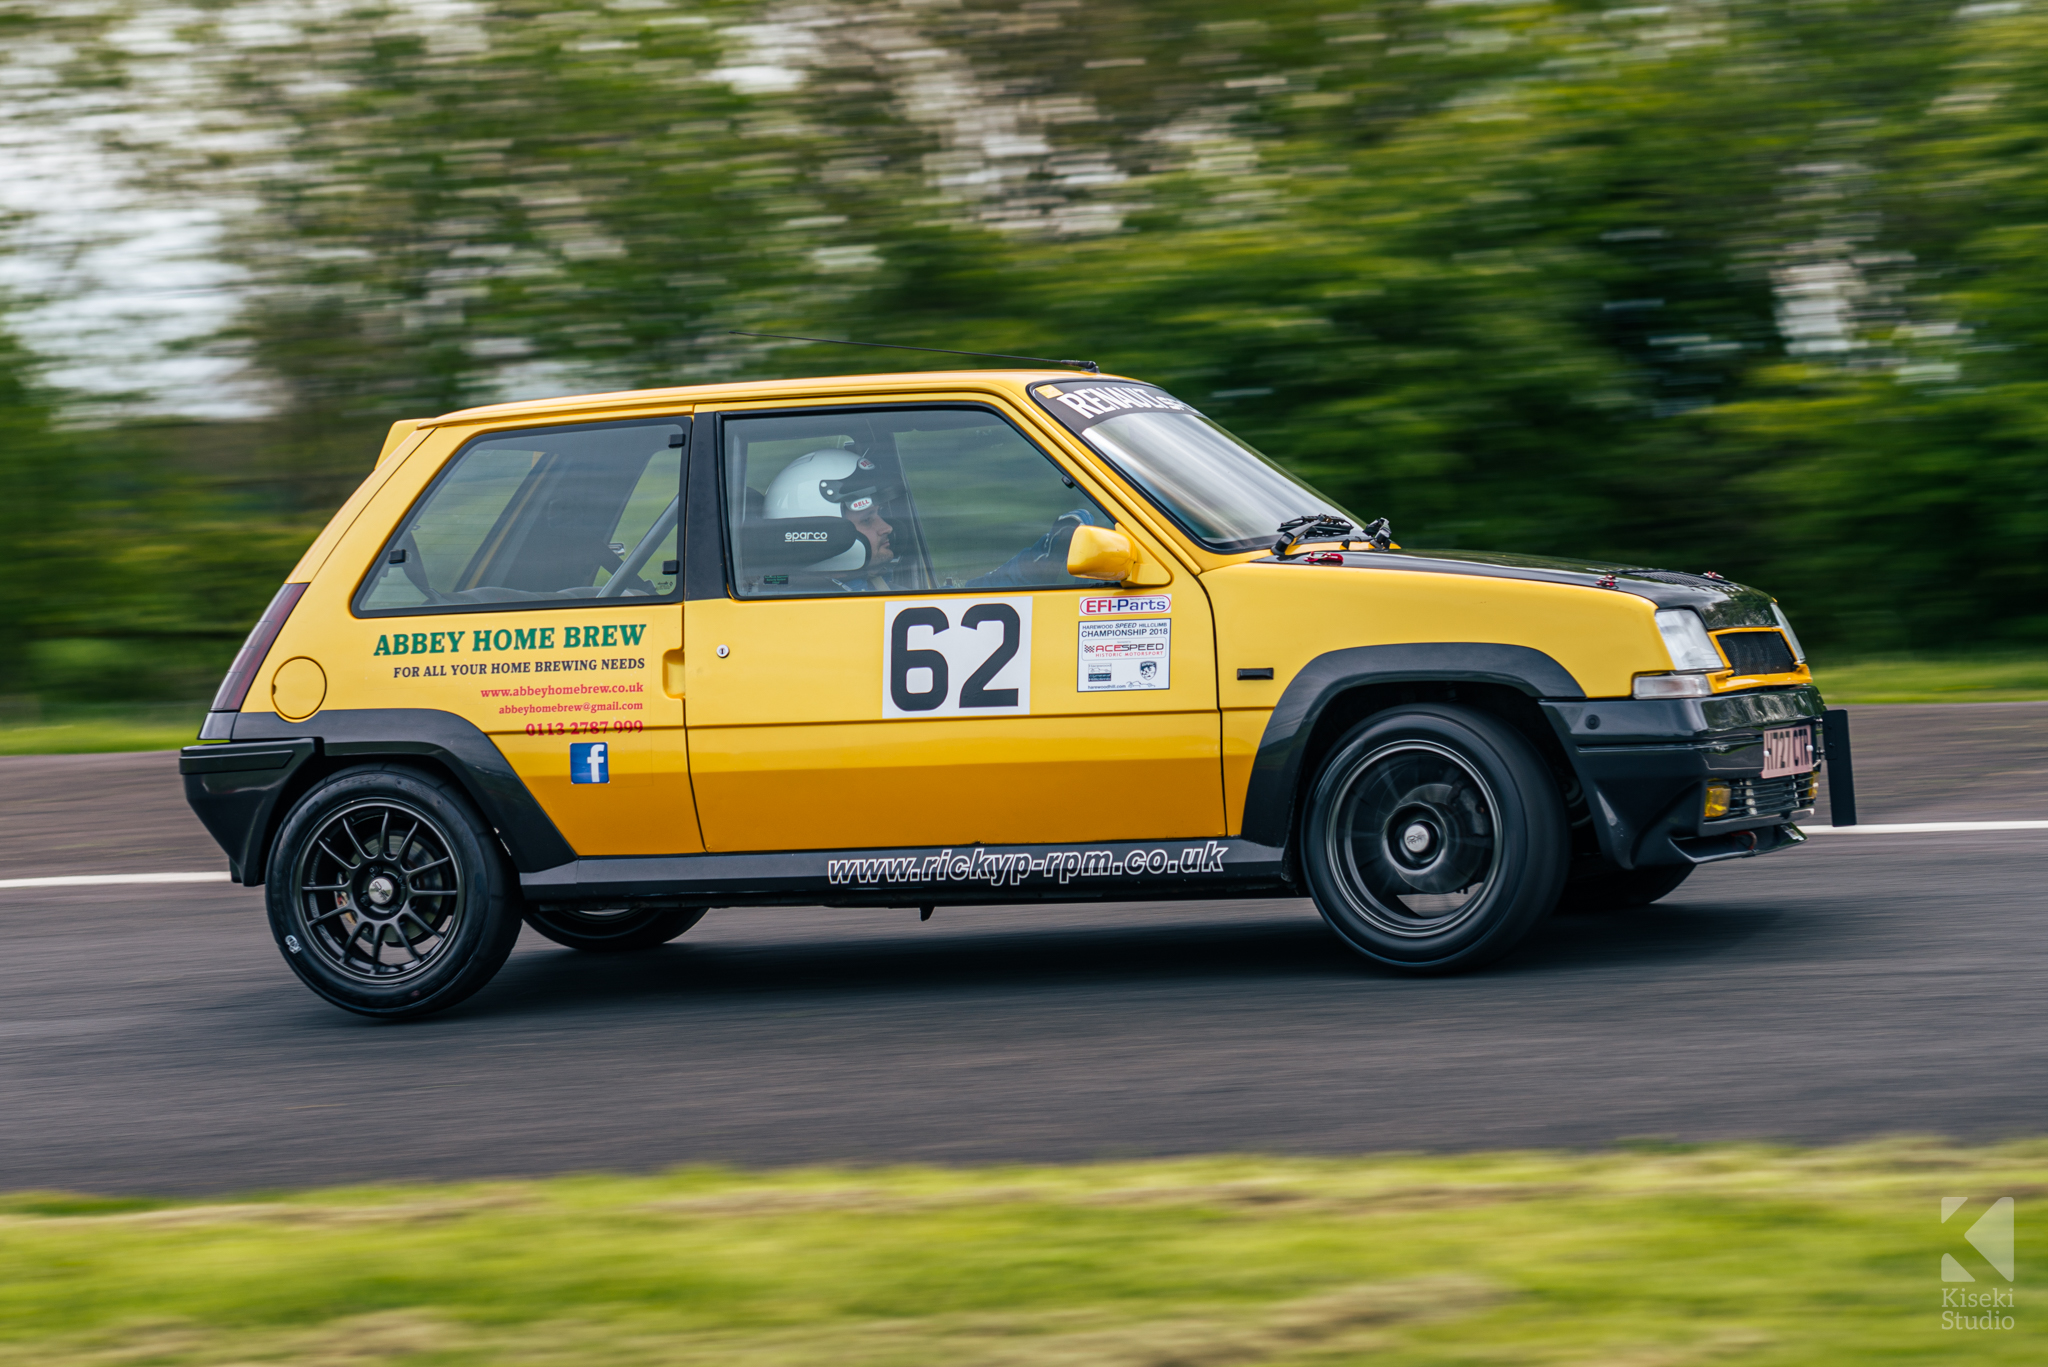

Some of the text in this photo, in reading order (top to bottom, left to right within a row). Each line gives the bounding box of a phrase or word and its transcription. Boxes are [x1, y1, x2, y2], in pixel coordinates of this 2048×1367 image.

[853, 499, 870, 509] BELL
[784, 531, 828, 543] sparco
[1086, 599, 1166, 613] EFI-Parts
[373, 623, 647, 656] ABBEY HOME BREW
[1081, 627, 1168, 638] CHAMPIONSHIP 2018
[1096, 643, 1164, 652] ACESPEED
[889, 602, 1021, 712] 62
[393, 657, 646, 678] FOR ALL YOUR HOME BREWING NEEDS
[480, 682, 644, 699] www.abbeyhomebrew.co.uk
[498, 701, 643, 716] abbeyhomebrew@gmail.com
[525, 719, 644, 736] 0113 2787 999
[828, 841, 1228, 886] www.rickyp-rpm.co.uk
